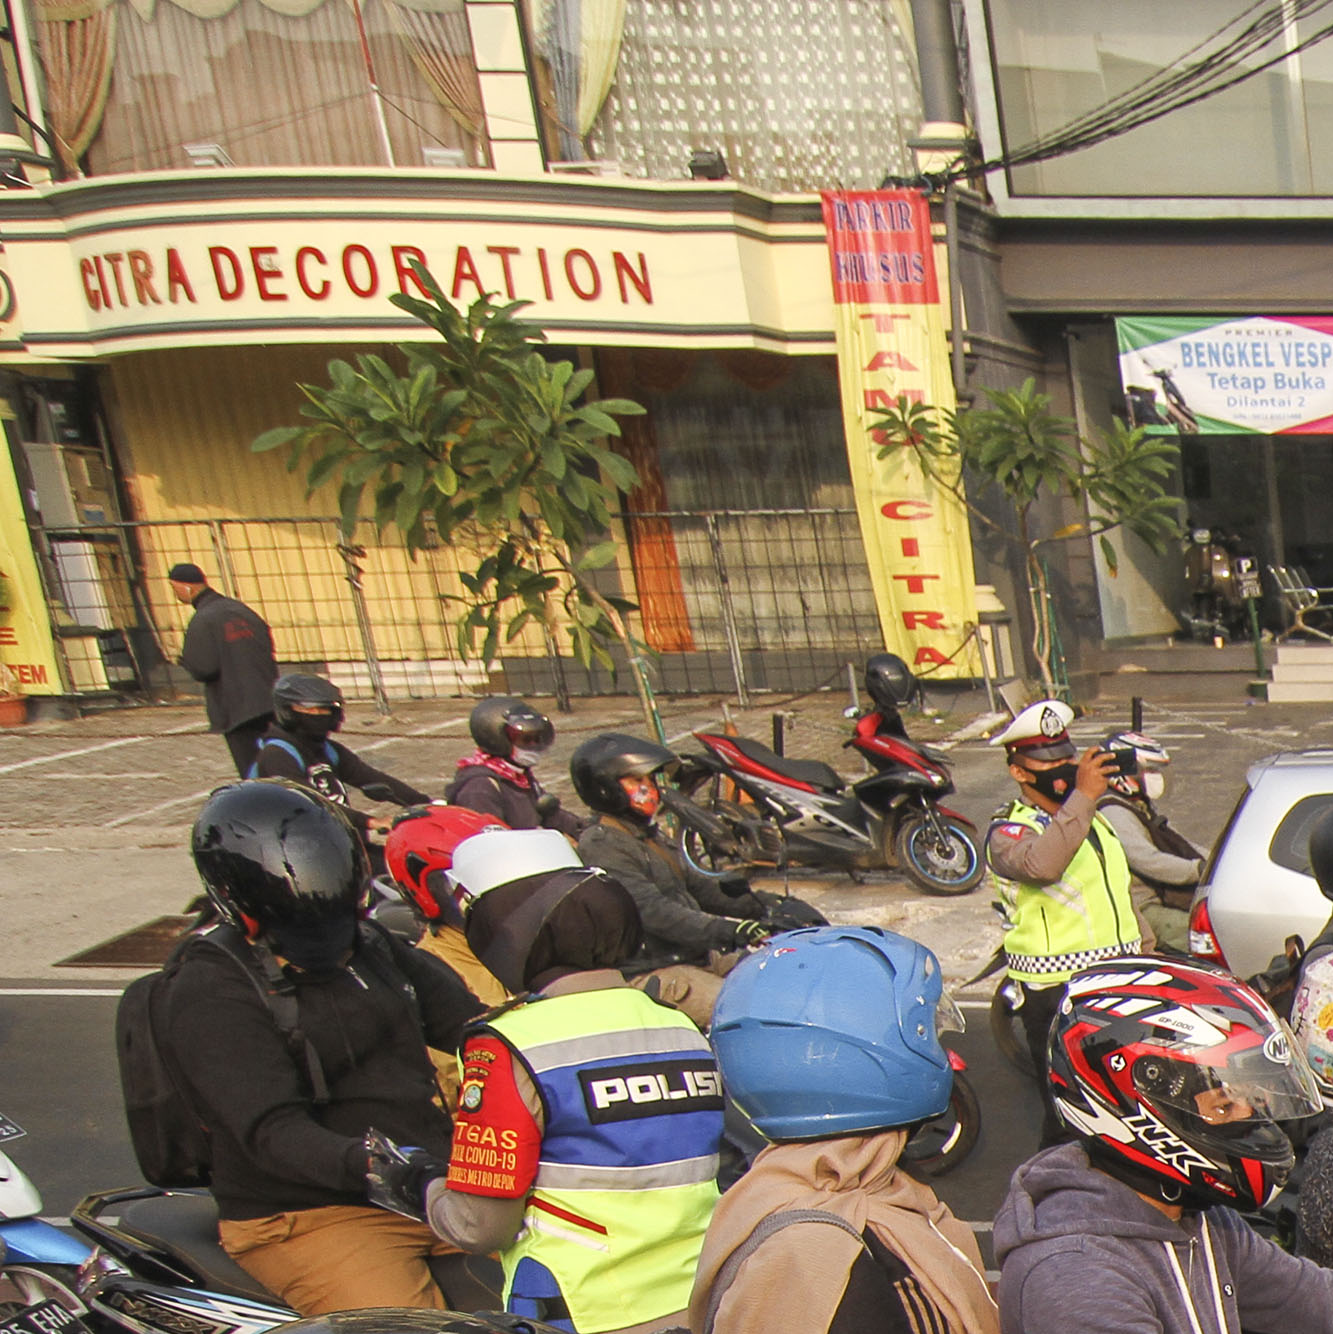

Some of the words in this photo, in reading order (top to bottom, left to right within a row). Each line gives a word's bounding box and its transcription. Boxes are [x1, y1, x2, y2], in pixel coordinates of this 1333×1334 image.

[834, 199, 914, 232] PARKIR
[79, 247, 198, 312] CITRA
[208, 243, 654, 306] DECORATION
[834, 251, 925, 284] KHUSUS
[1224, 329, 1294, 337] PREMIER
[1180, 341, 1275, 368] BENGKEL
[1206, 372, 1268, 395] Tetap
[1274, 372, 1326, 391] Buka
[1227, 396, 1293, 408] Dilantai
[1297, 396, 1306, 408] 2
[1240, 559, 1252, 573] P
[880, 500, 956, 666] CITRA
[1270, 1040, 1290, 1056] NH
[590, 1071, 723, 1109] POLISI
[1121, 1102, 1219, 1178] NHK
[465, 1147, 517, 1171] COVID-19
[28, 1303, 75, 1333] EHA
